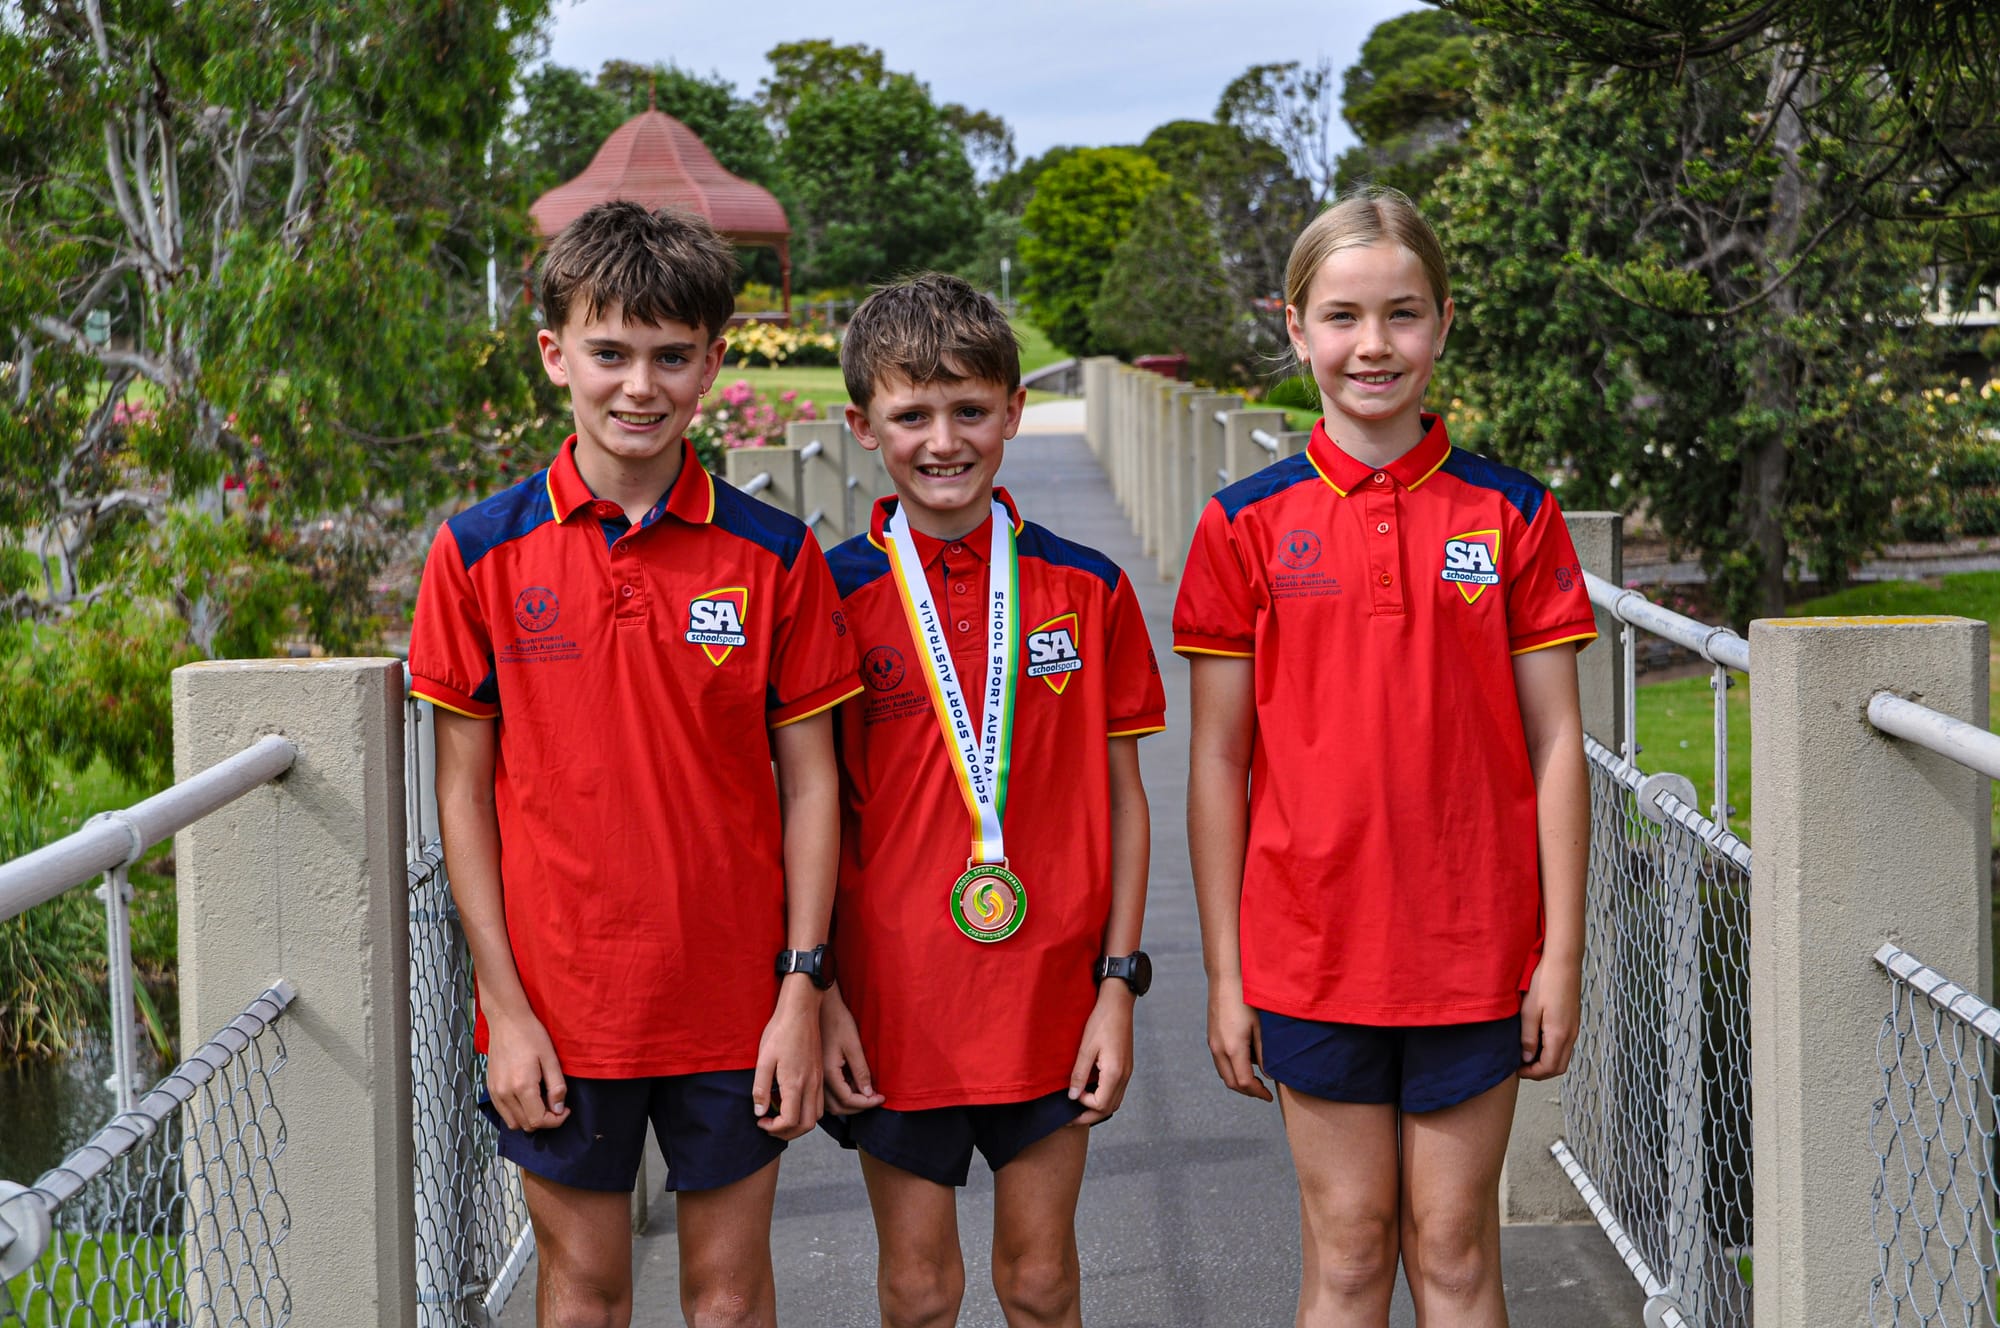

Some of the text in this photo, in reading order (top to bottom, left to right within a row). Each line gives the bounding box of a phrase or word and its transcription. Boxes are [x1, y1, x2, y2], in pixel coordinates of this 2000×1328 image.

[1446, 540, 1495, 572] SA
[1301, 578, 1337, 586] Australia
[1445, 571, 1494, 584] schoolsport
[690, 600, 742, 633] SA
[994, 591, 1004, 650] SCHOOL
[515, 634, 564, 645] Government
[540, 640, 577, 650] Australia
[691, 632, 740, 645] schoolsport
[1028, 629, 1077, 663] SA
[989, 656, 1003, 707] SPORT
[1032, 661, 1077, 675] schoolsport
[919, 599, 989, 804] SCHOOL SPORT AUSTRALIA
[973, 867, 993, 876] SPORT
[995, 868, 1022, 894] AUSTRALIA
